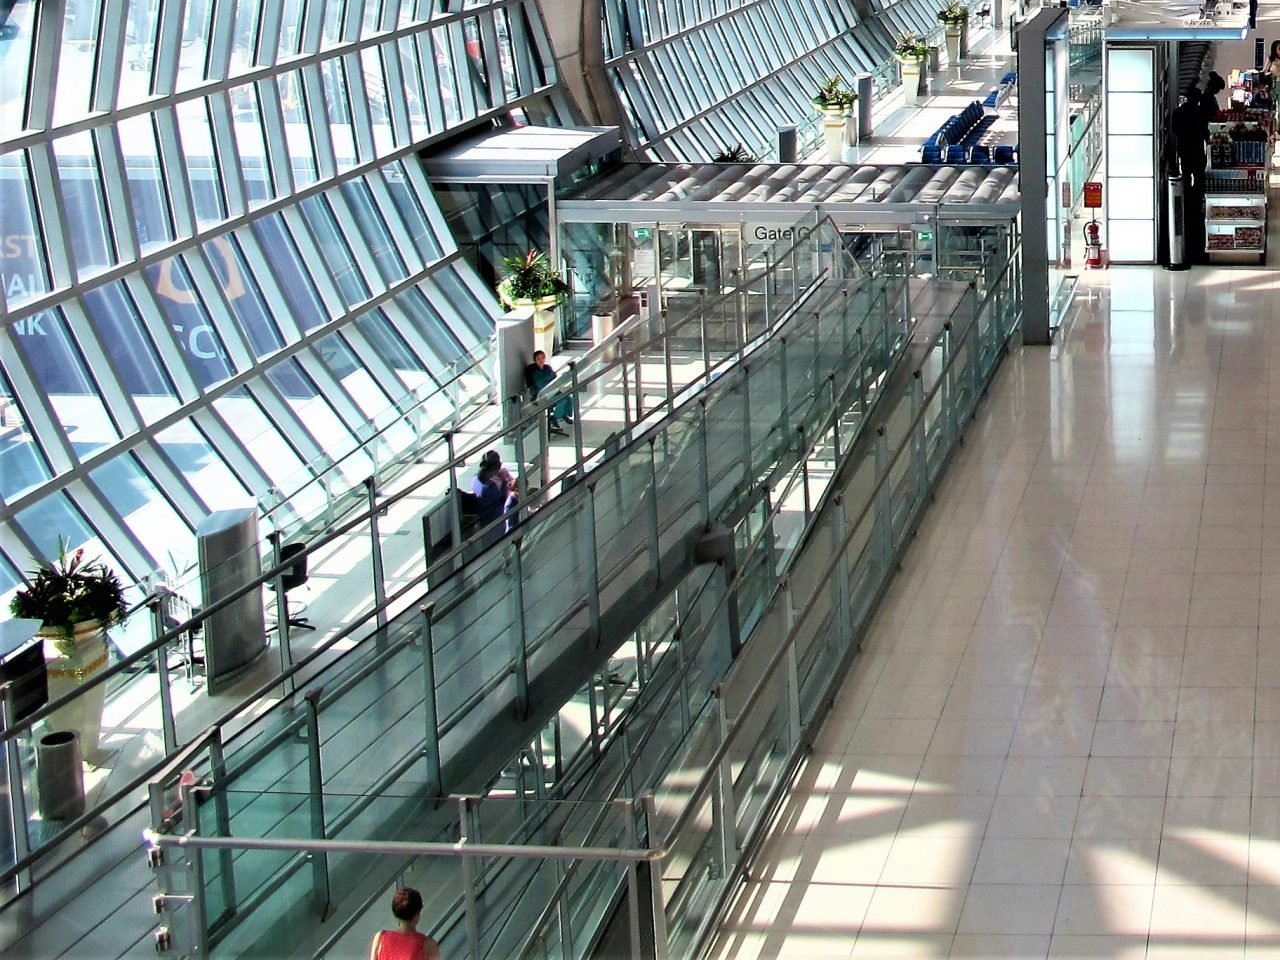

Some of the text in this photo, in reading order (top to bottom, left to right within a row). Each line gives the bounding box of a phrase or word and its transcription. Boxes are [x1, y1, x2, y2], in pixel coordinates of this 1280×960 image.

[754, 226, 811, 240] Gate G
[0, 235, 38, 259] ST
